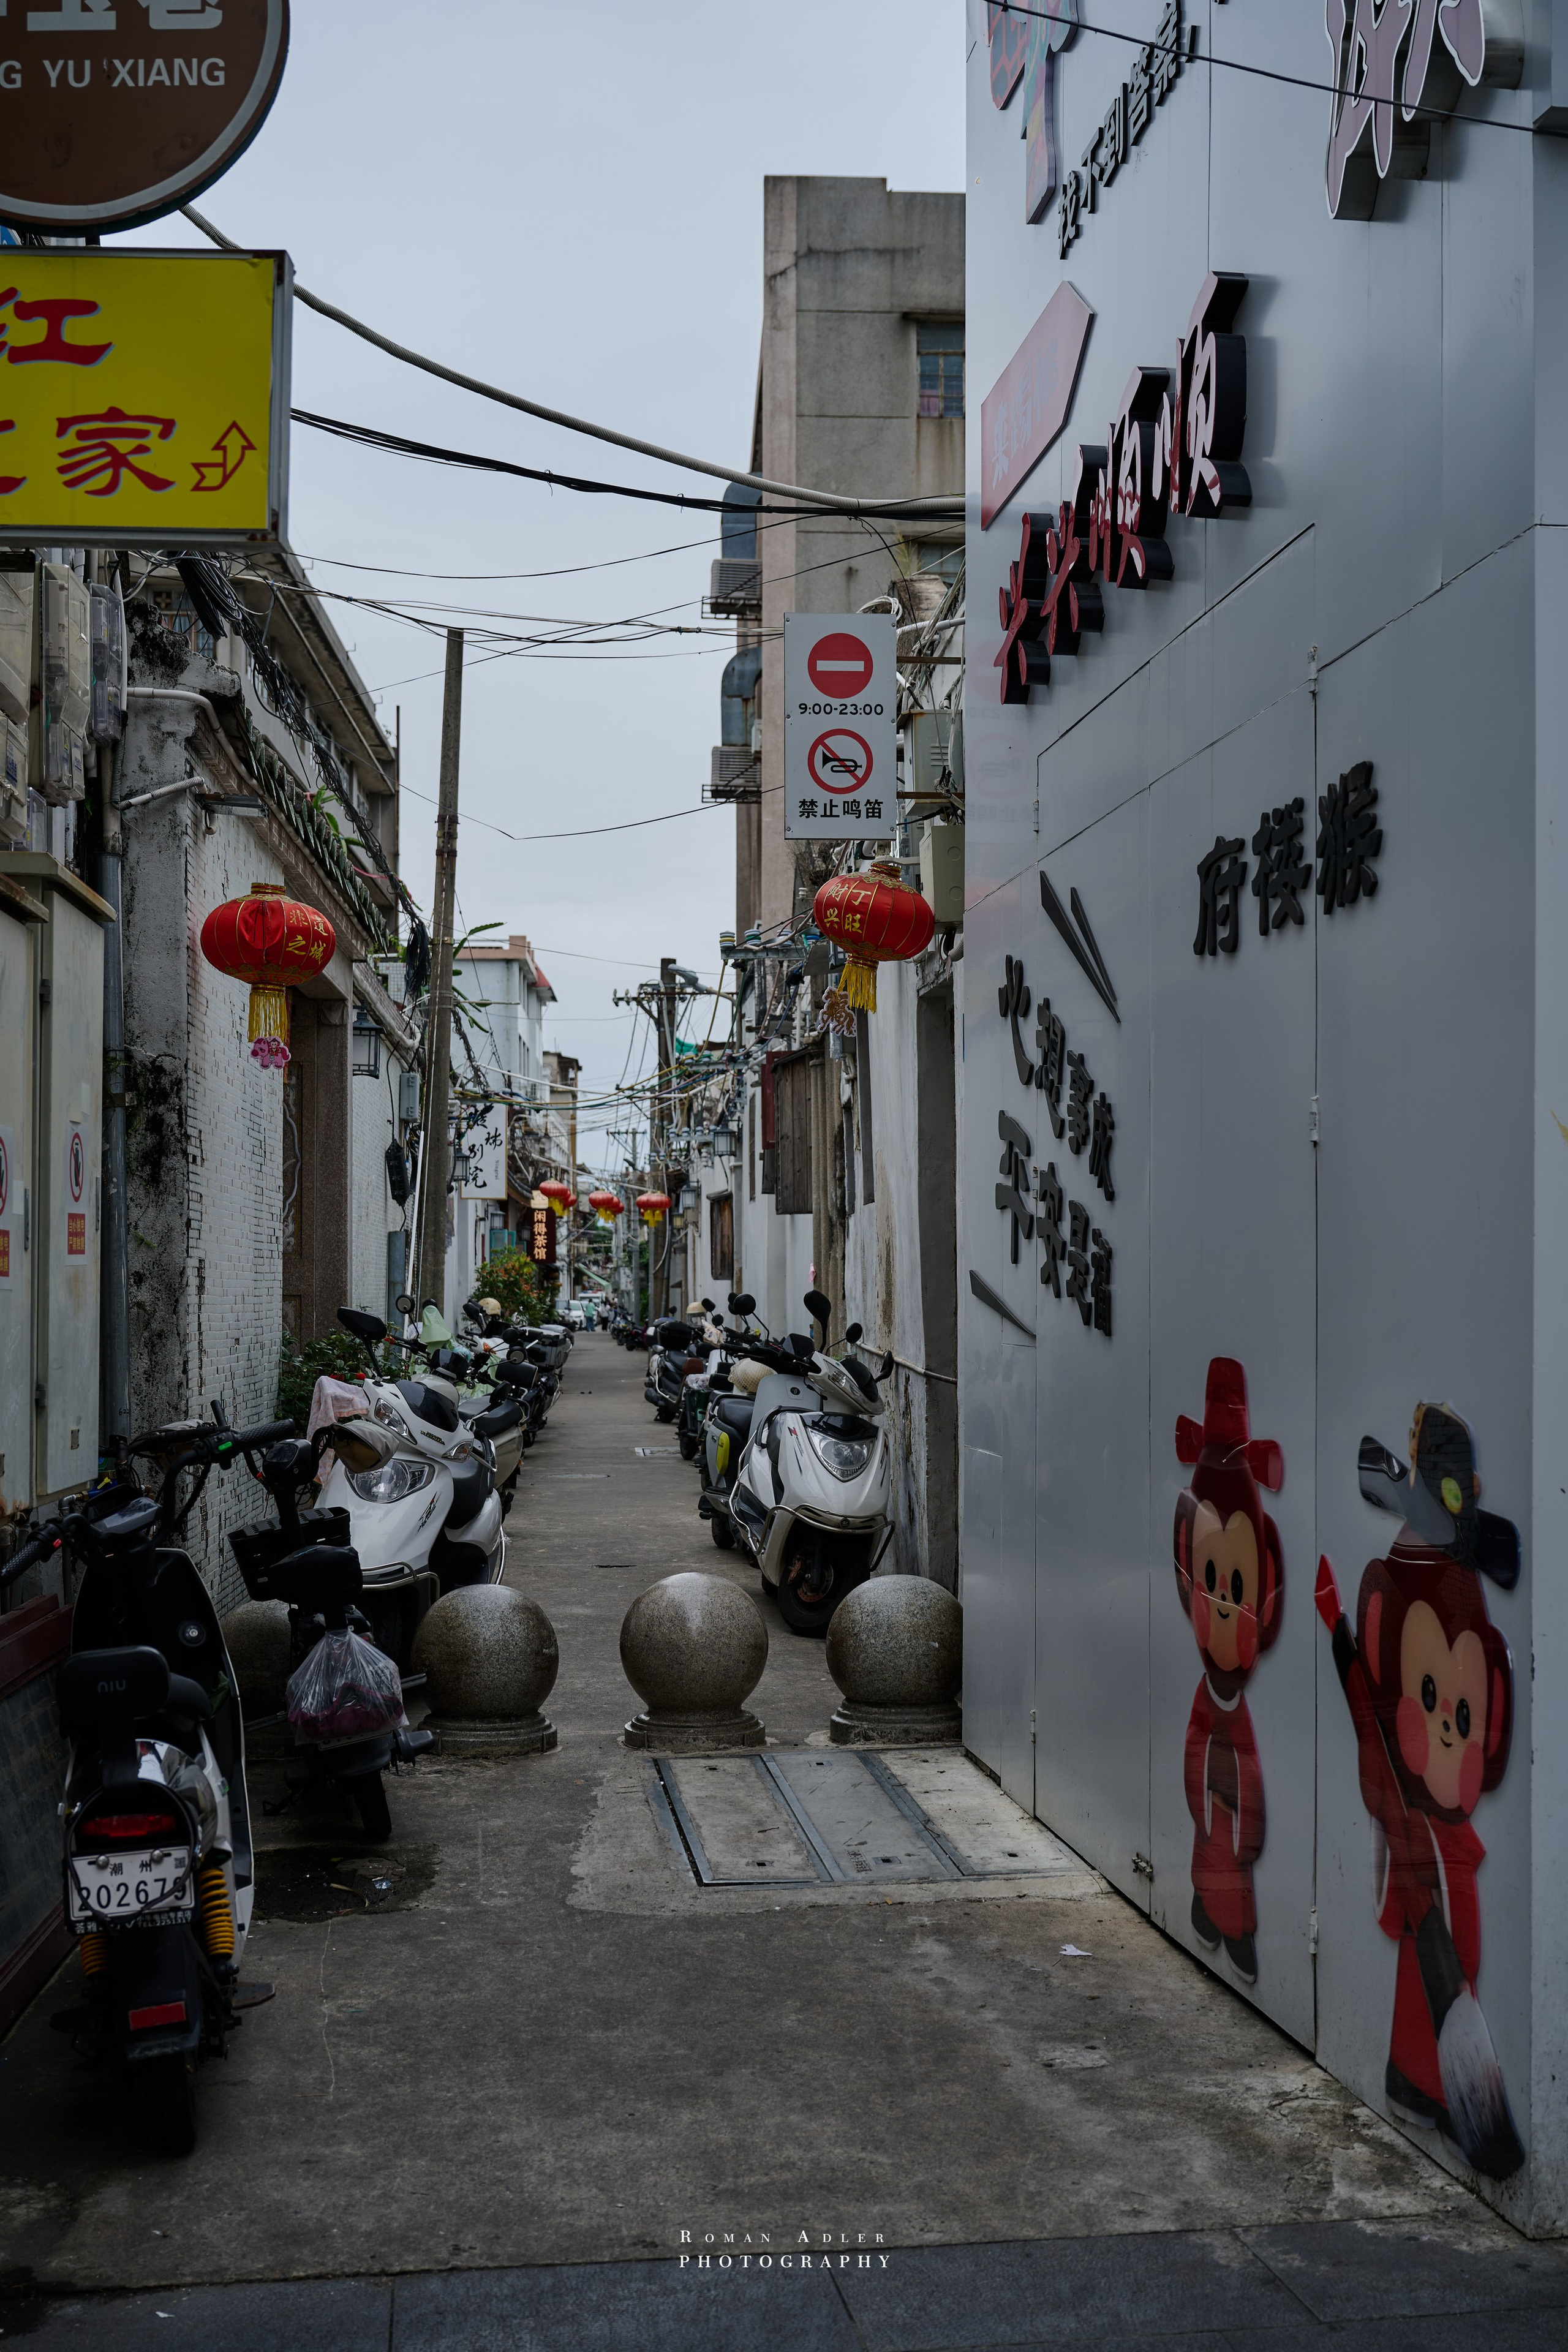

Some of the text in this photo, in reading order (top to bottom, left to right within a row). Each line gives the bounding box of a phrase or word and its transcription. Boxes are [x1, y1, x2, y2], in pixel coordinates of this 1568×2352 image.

[42, 59, 91, 88] YU
[111, 57, 225, 88] XIANG
[798, 703, 884, 715] 9:00-23:00
[798, 798, 884, 820] 禁止鸣笛
[827, 883, 872, 906] 财丁
[824, 907, 862, 934] 兴旺
[285, 934, 326, 965] 之城
[998, 954, 1115, 1202] 心想事成
[995, 1110, 1113, 1337] 平安是福
